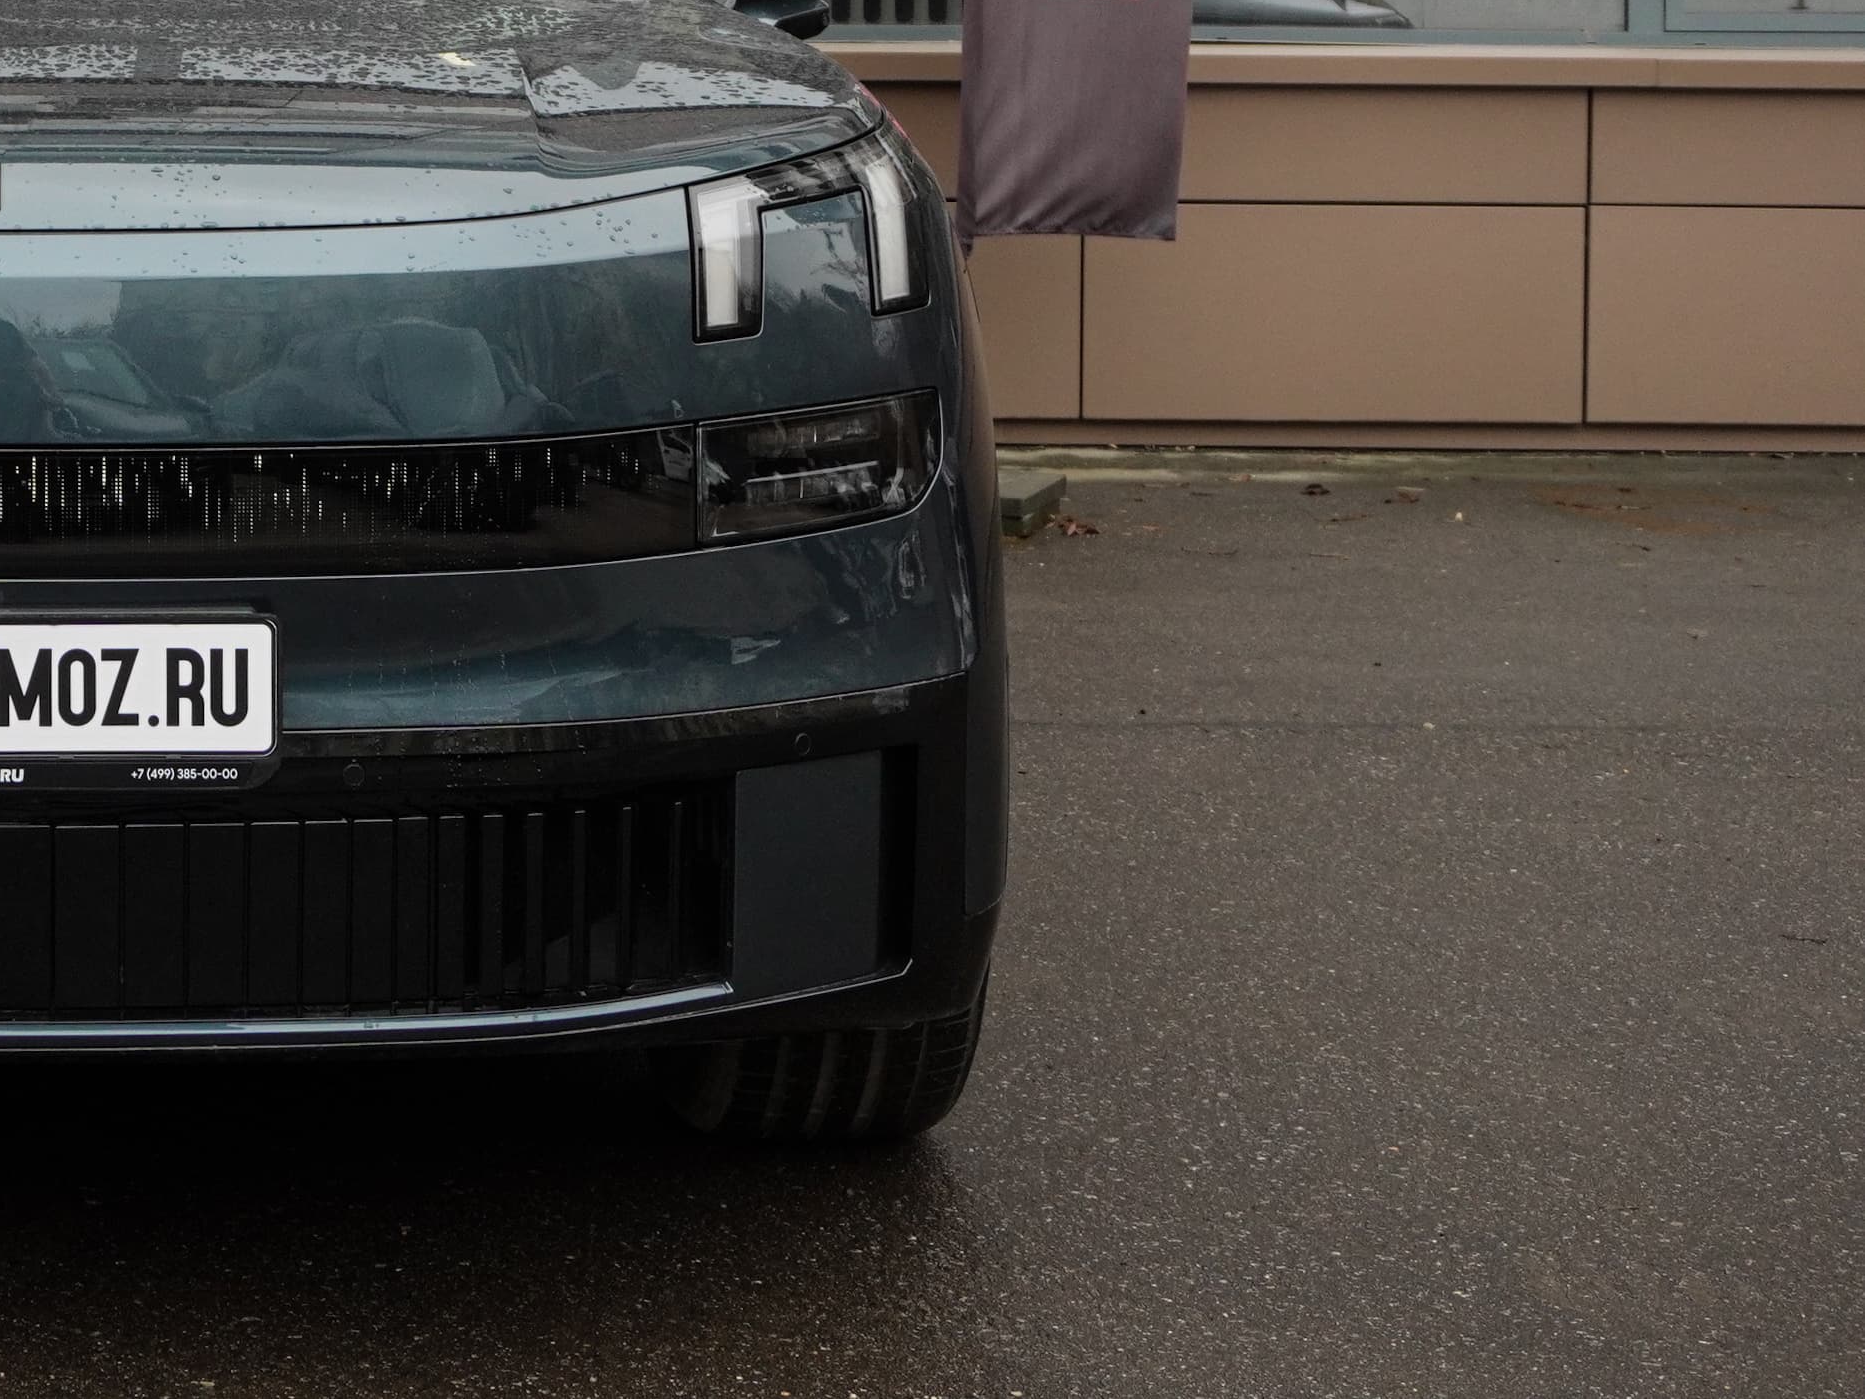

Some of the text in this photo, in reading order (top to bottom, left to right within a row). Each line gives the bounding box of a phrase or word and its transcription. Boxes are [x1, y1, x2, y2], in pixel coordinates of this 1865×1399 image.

[130, 767, 238, 782] +7 (499) 385-00-00
